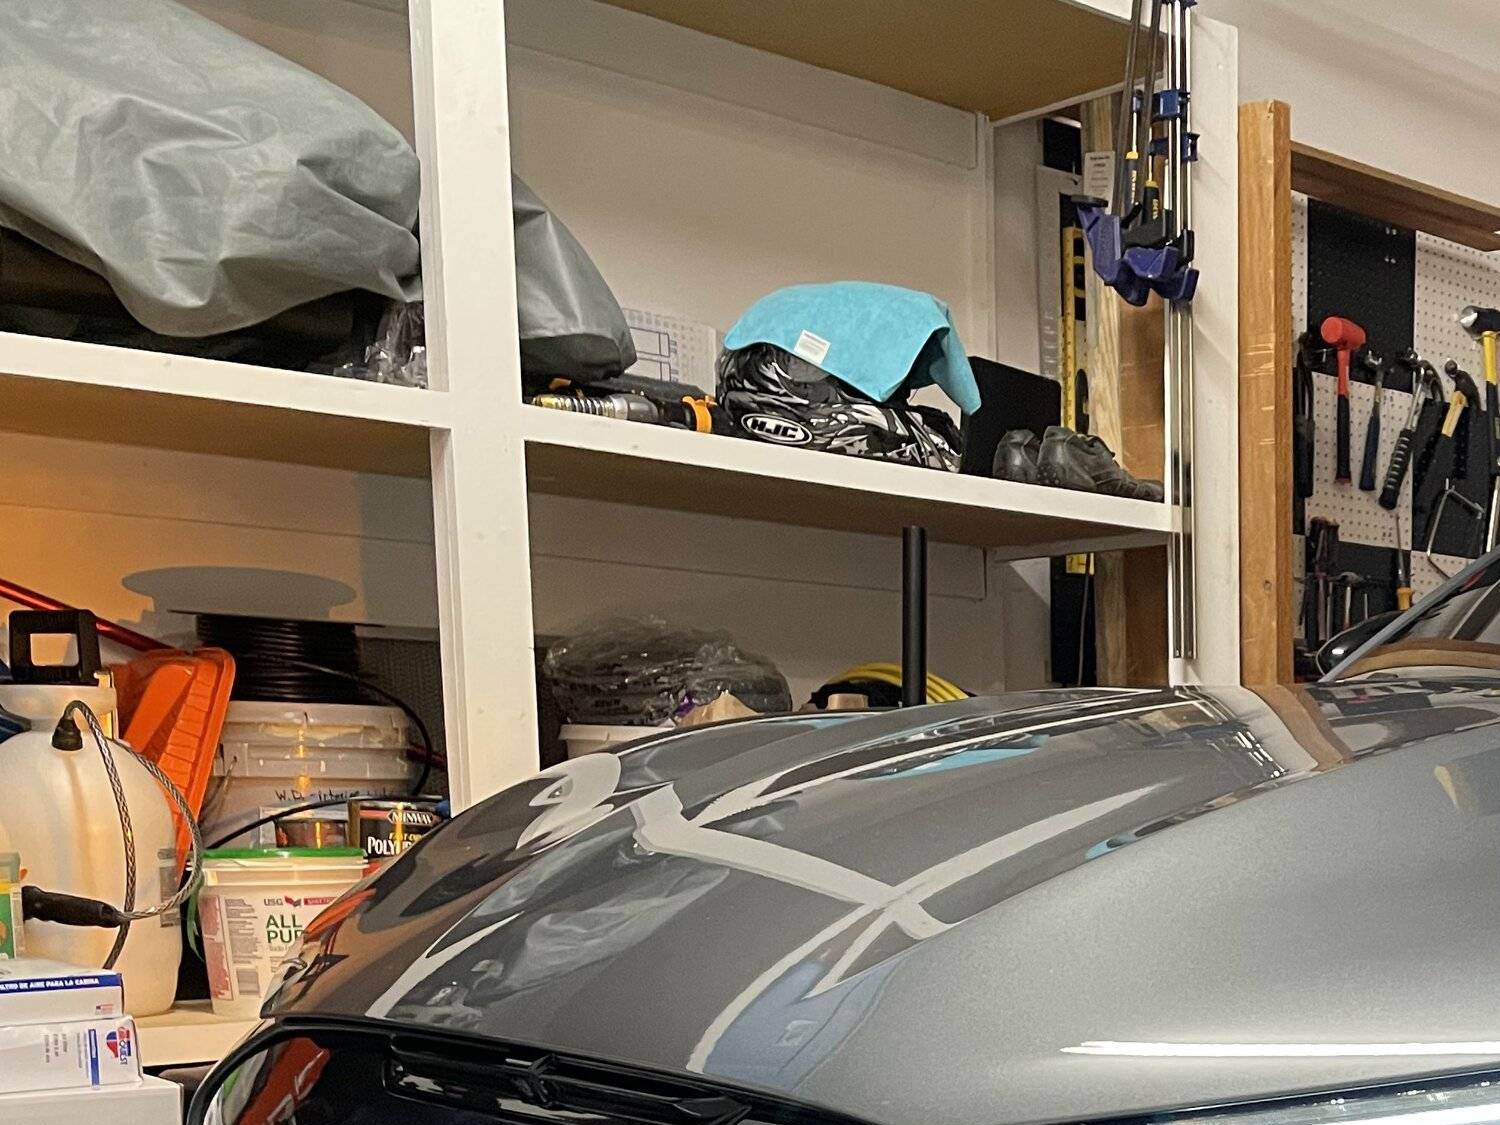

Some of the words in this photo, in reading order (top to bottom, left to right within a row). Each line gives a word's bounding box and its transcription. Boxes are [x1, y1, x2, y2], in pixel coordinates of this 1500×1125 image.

[751, 418, 799, 438] HJC
[263, 898, 284, 907] USG
[266, 914, 303, 929] ALL
[46, 979, 65, 988] PARA
